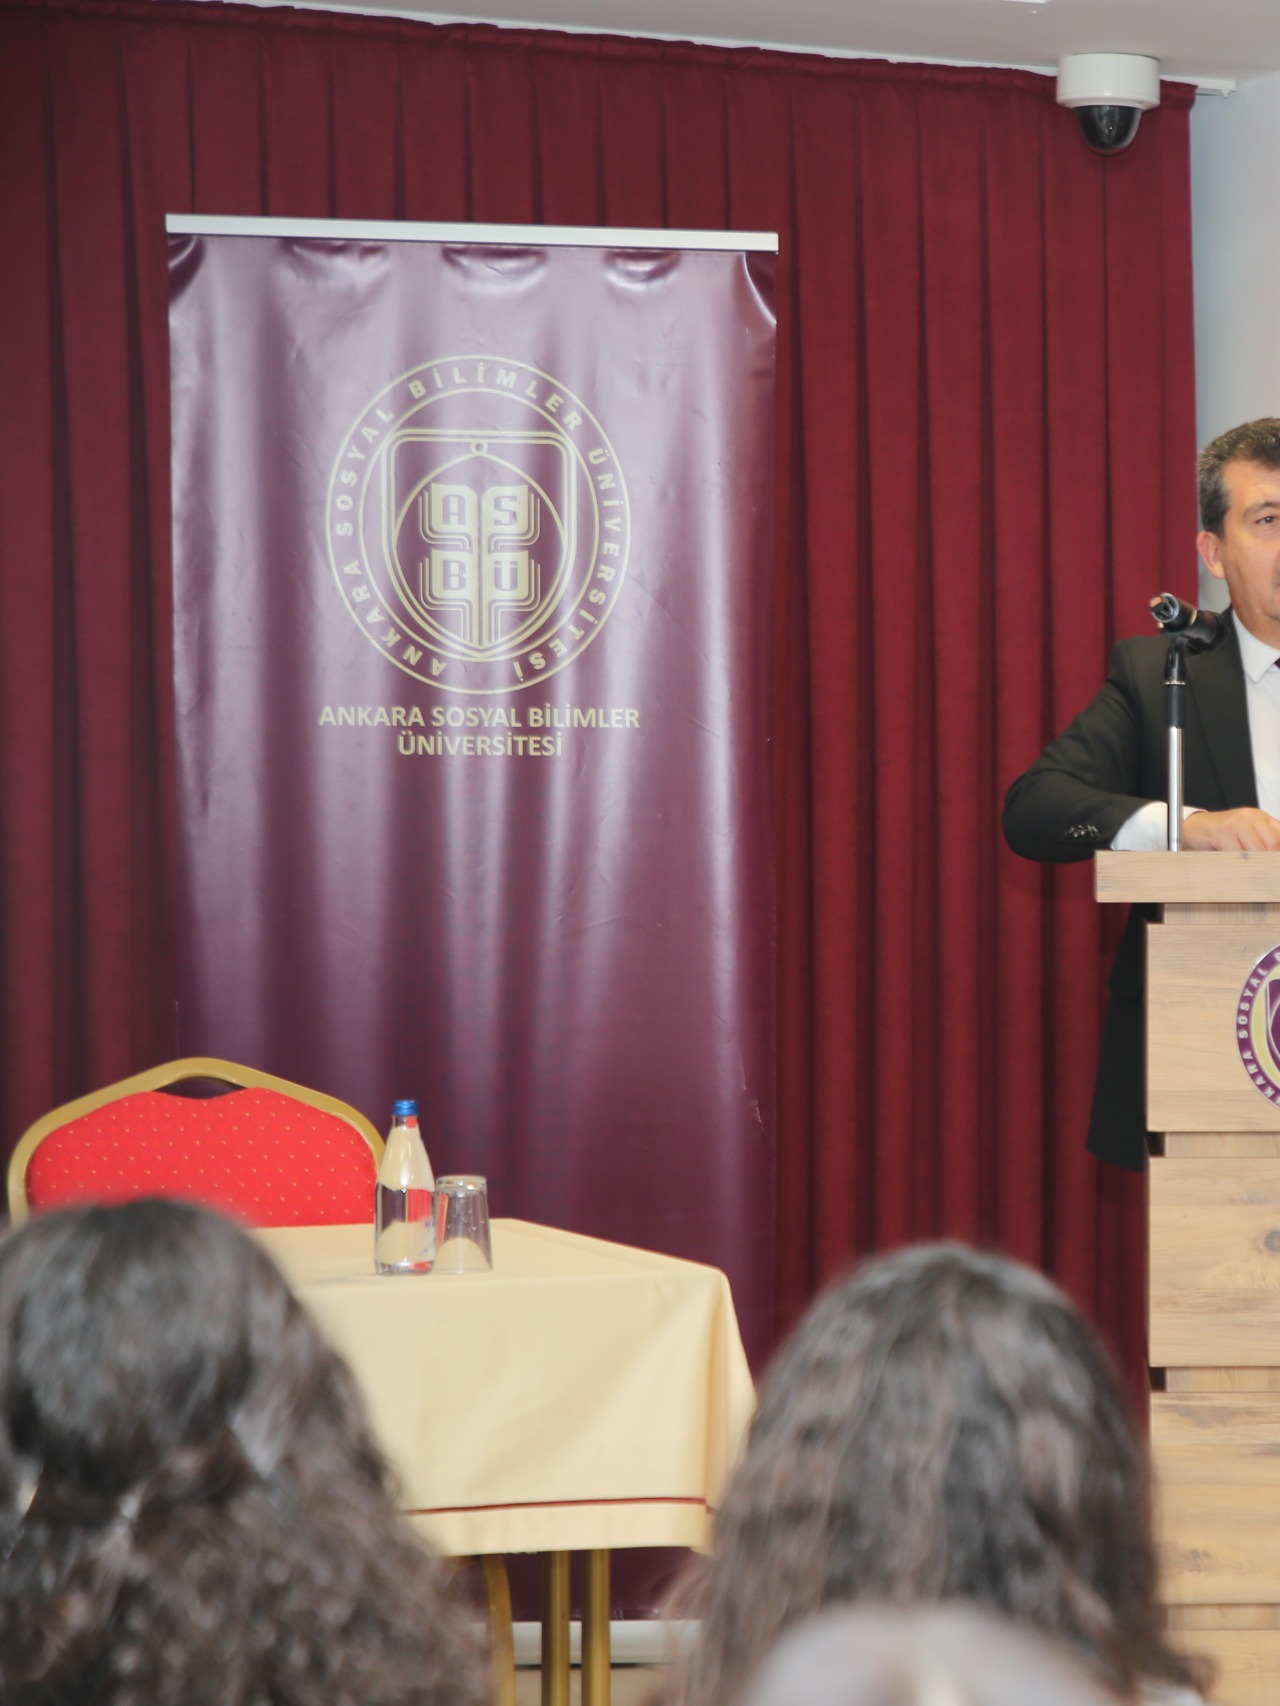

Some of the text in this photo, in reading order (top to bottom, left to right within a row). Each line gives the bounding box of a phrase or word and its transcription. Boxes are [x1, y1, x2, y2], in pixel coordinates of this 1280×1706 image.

[336, 408, 396, 537] SOSYAL
[343, 560, 448, 676] ANKARA
[318, 703, 640, 728] ANKARA SOSYAL BİLİMLER
[398, 730, 562, 757] ÜNİVERSİTESİ
[1238, 968, 1268, 1039] SOSYAL
